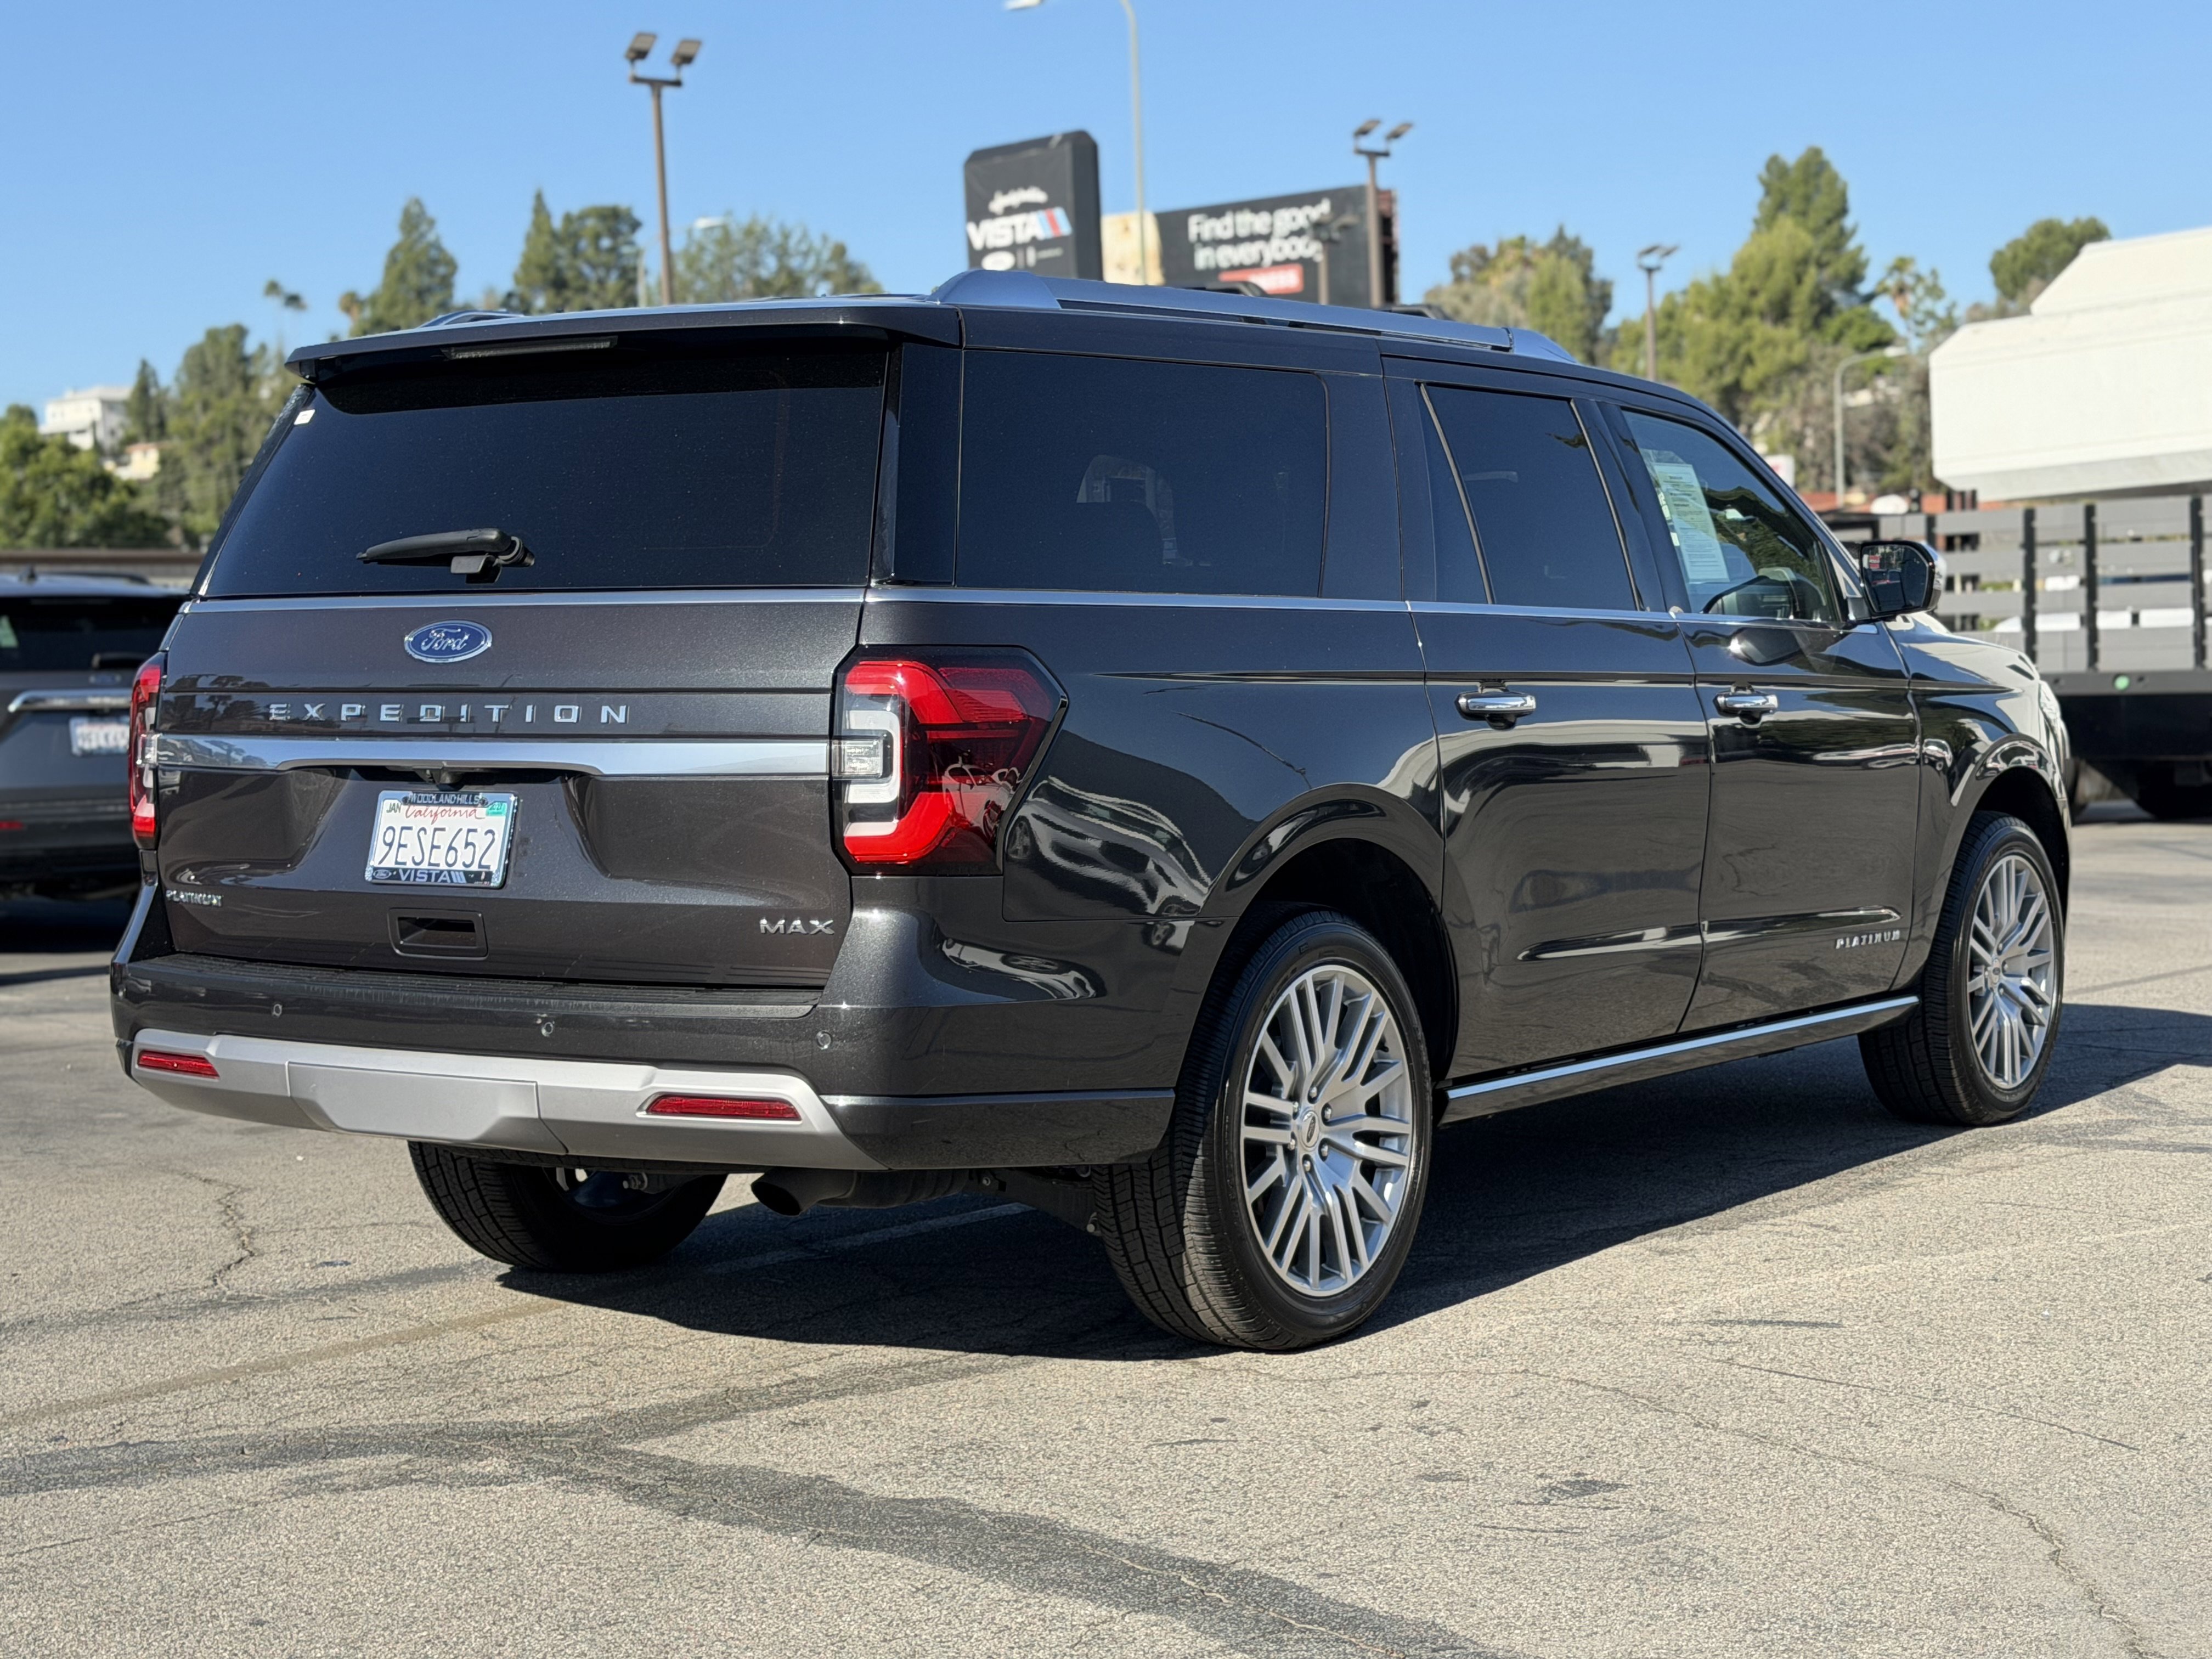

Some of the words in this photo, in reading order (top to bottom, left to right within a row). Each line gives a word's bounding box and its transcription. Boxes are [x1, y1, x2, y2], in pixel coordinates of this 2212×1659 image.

[967, 212, 1045, 250] VISTA
[1188, 211, 1234, 242] Find
[1235, 208, 1272, 238] the
[1194, 242, 1216, 270] in
[421, 628, 470, 651] Ford
[269, 703, 629, 724] EXPEDITION
[386, 803, 401, 813] JAN
[409, 793, 456, 804] WOODLAND
[457, 794, 479, 805] HILLS
[405, 804, 486, 825] California
[378, 826, 496, 870] 9ESE652
[399, 868, 450, 883] VISTA
[759, 918, 835, 935] MAX
[1836, 930, 1900, 949] PLATINUM
